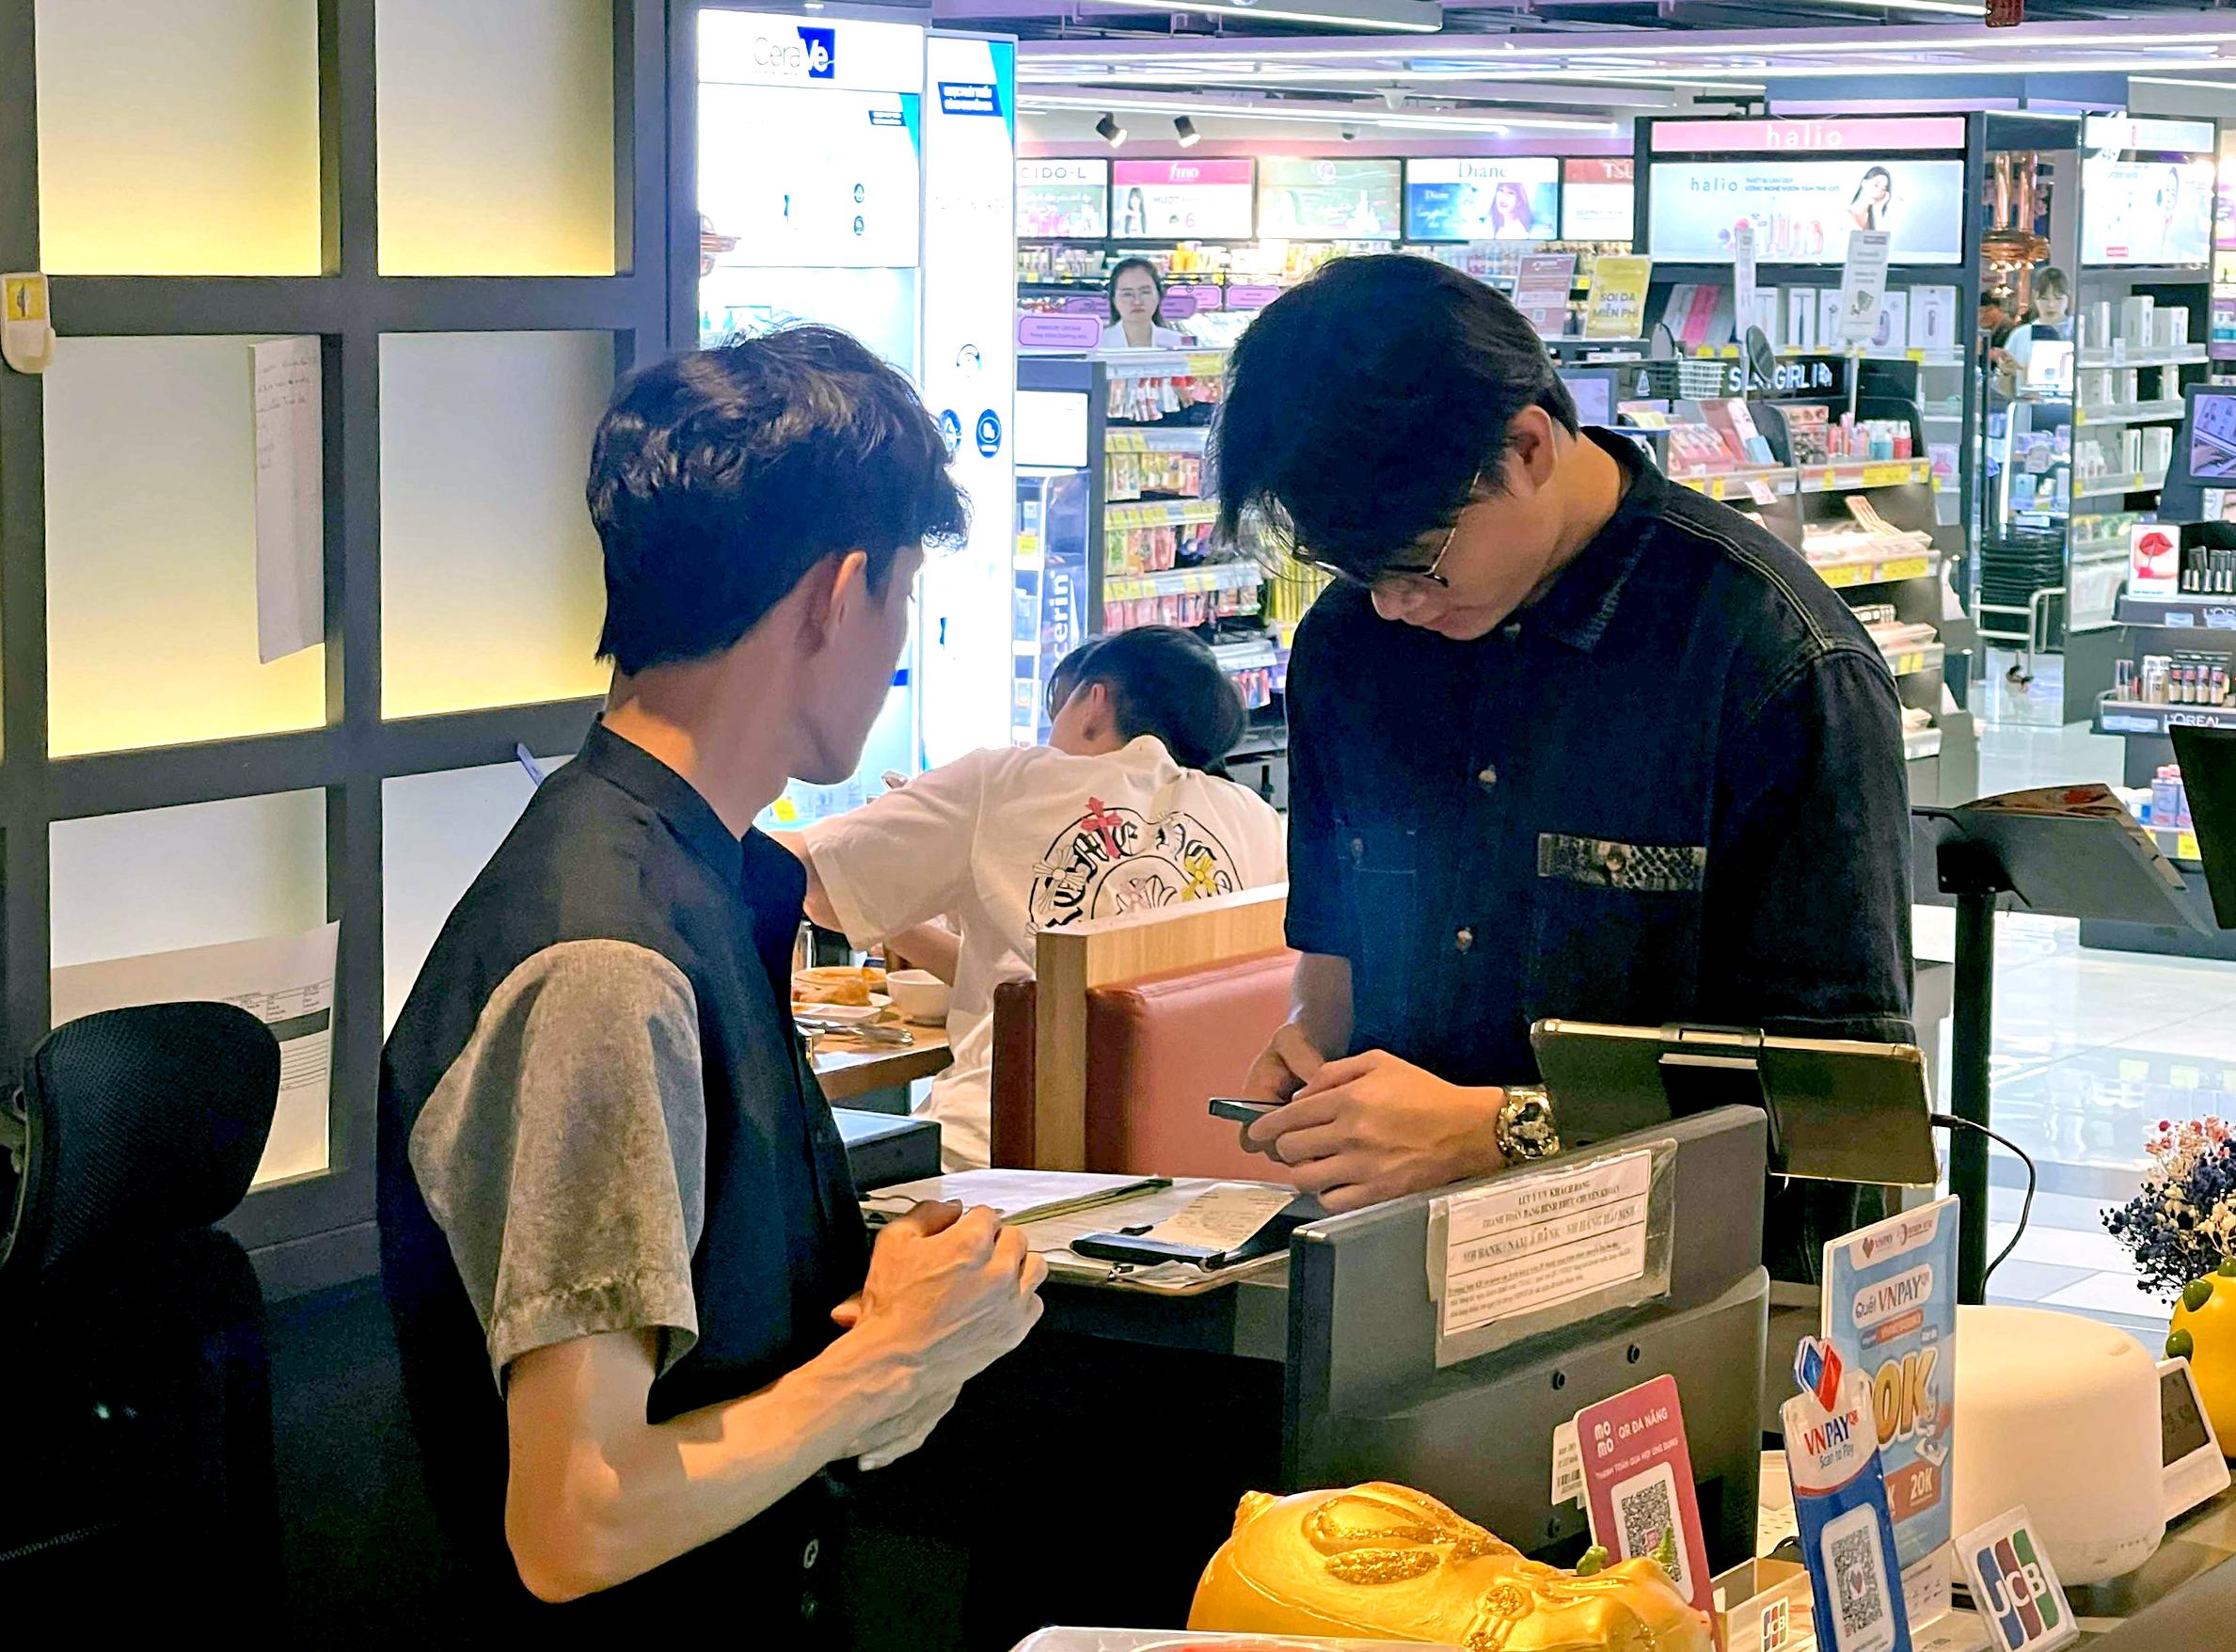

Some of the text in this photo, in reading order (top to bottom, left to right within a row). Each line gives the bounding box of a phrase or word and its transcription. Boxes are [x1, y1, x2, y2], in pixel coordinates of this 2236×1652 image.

[753, 37, 830, 72] CeraVe
[1768, 123, 1843, 148] halio
[1457, 161, 1507, 179] Diane
[1690, 177, 1738, 192] halio
[1049, 574, 1069, 664] cerin
[1911, 1467, 1933, 1501] 20K
[1992, 1562, 2047, 1619] JCB
[1764, 1615, 1785, 1640] JCB
